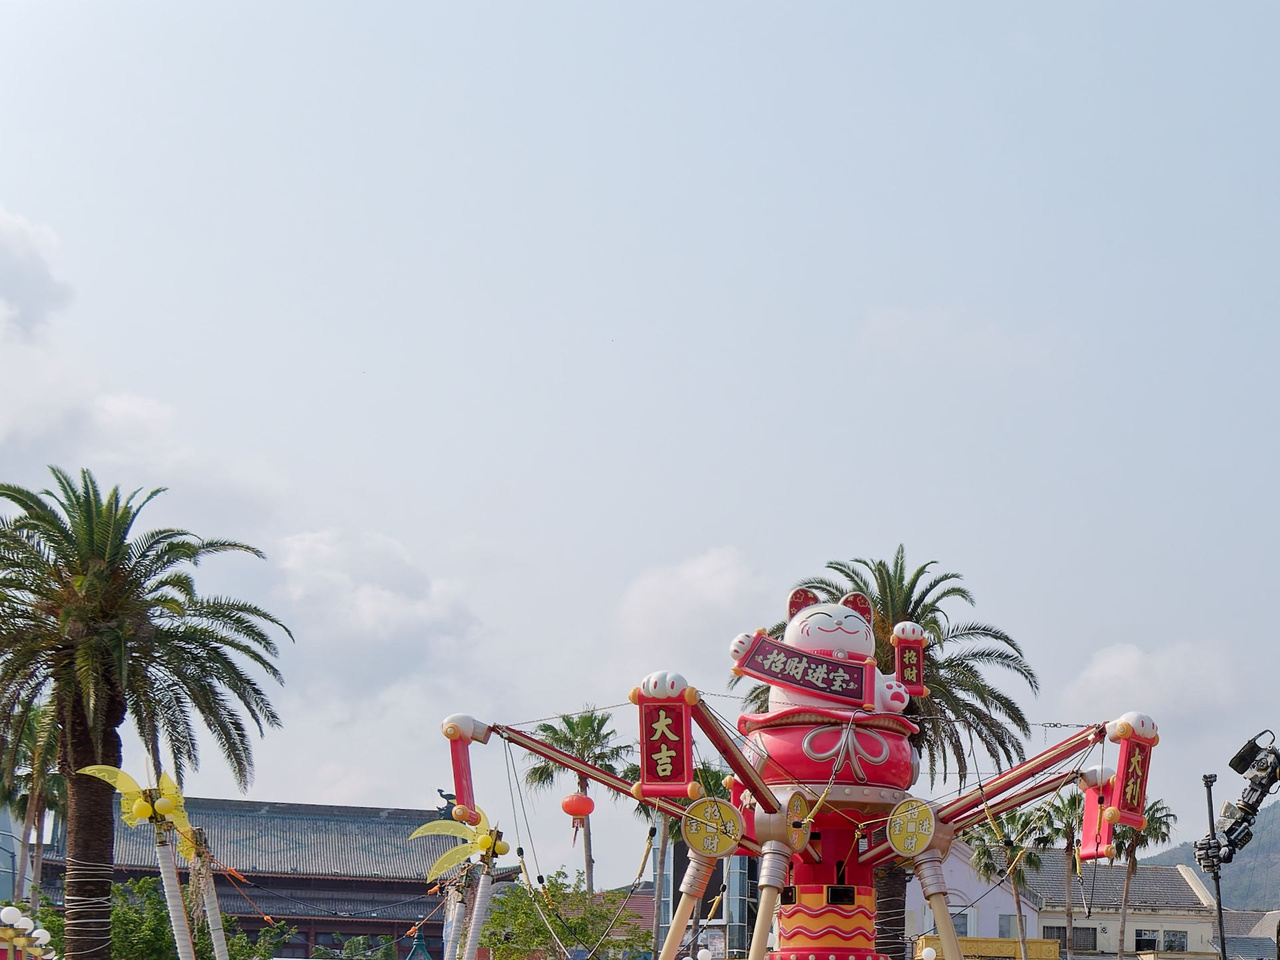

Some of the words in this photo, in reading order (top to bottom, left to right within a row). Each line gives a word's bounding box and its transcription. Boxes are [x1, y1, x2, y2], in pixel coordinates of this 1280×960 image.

[762, 650, 850, 691] 招财进宝
[903, 650, 918, 682] 招财
[650, 709, 680, 777] 大吉
[1126, 747, 1143, 806] 大利
